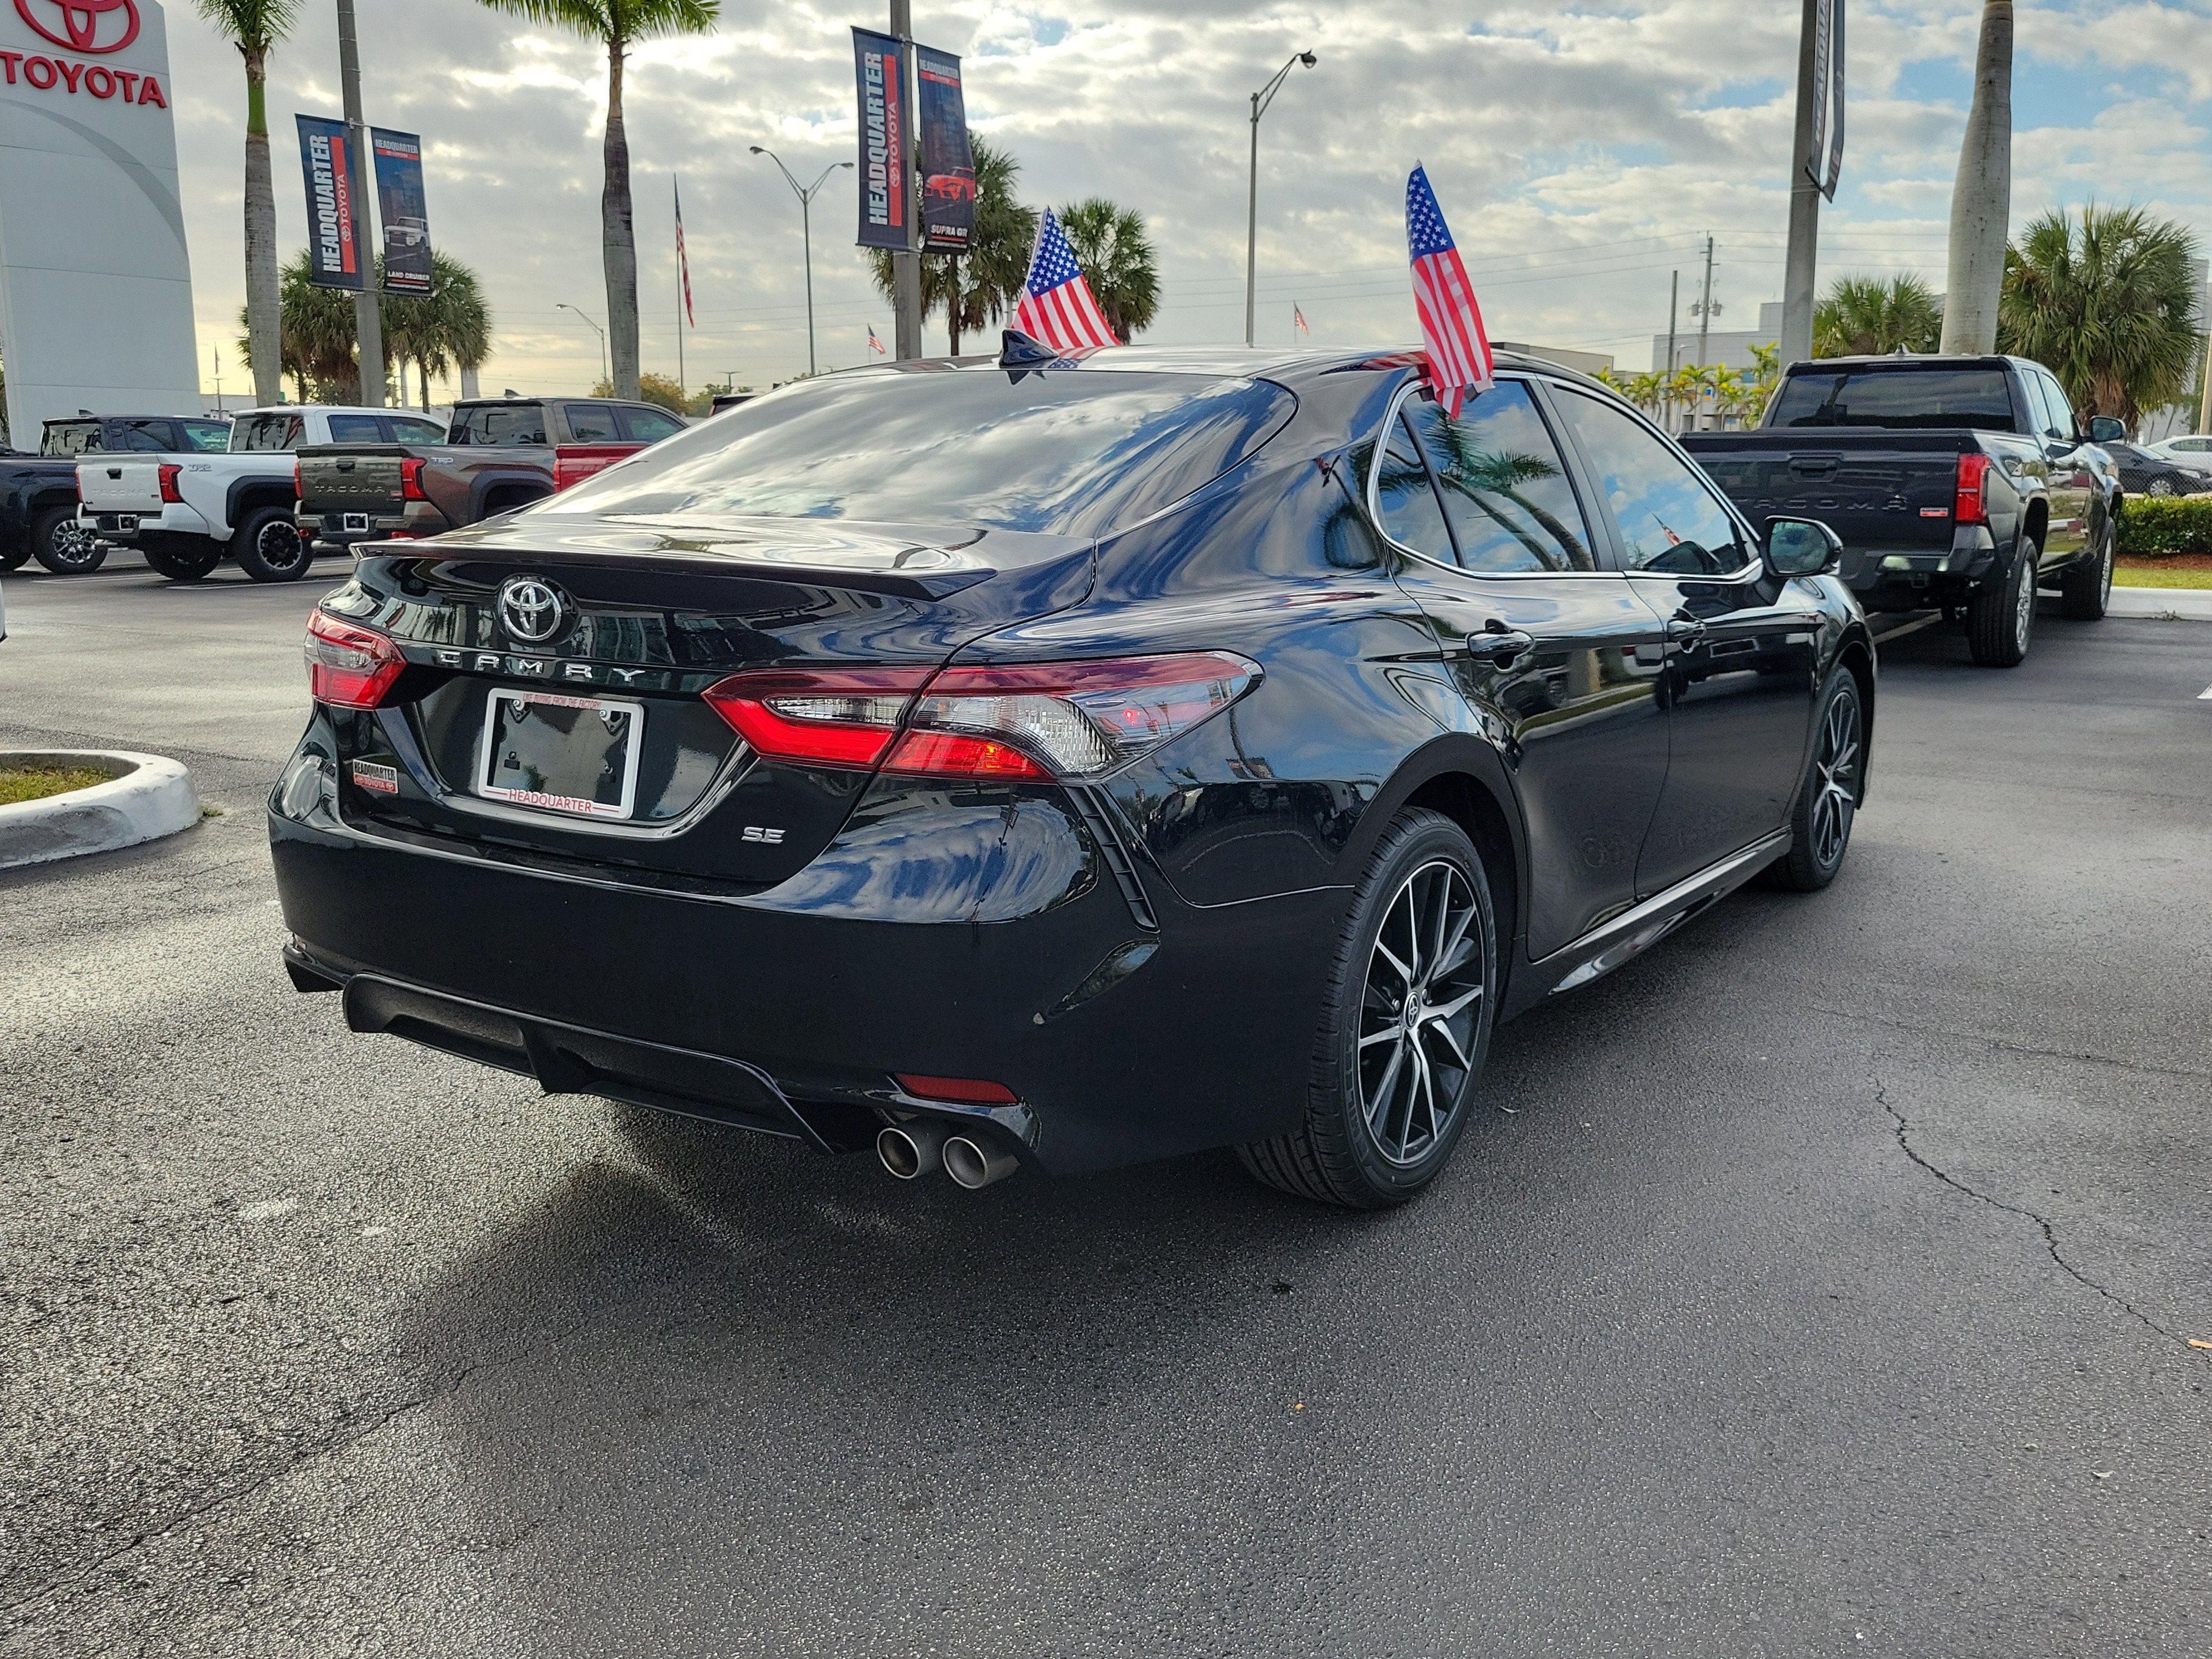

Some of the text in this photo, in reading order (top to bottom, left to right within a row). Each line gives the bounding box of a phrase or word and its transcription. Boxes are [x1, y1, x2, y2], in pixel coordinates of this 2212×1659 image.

[0, 50, 167, 109] TOYOTA
[865, 52, 889, 225] HEADQUARTER
[887, 102, 900, 165] TOYOTA
[375, 139, 419, 154] HEADQUARTER
[309, 135, 342, 273] HEADQUARTER
[336, 174, 352, 224] TOYOTA
[930, 224, 968, 238] SUPRA GR
[386, 270, 404, 279] LAND
[440, 651, 646, 682] CAMRY
[354, 761, 396, 781] HEADQUARTER
[365, 778, 386, 789] TOYOTA
[509, 788, 592, 812] HEADQUARTER
[741, 826, 787, 844] SE
